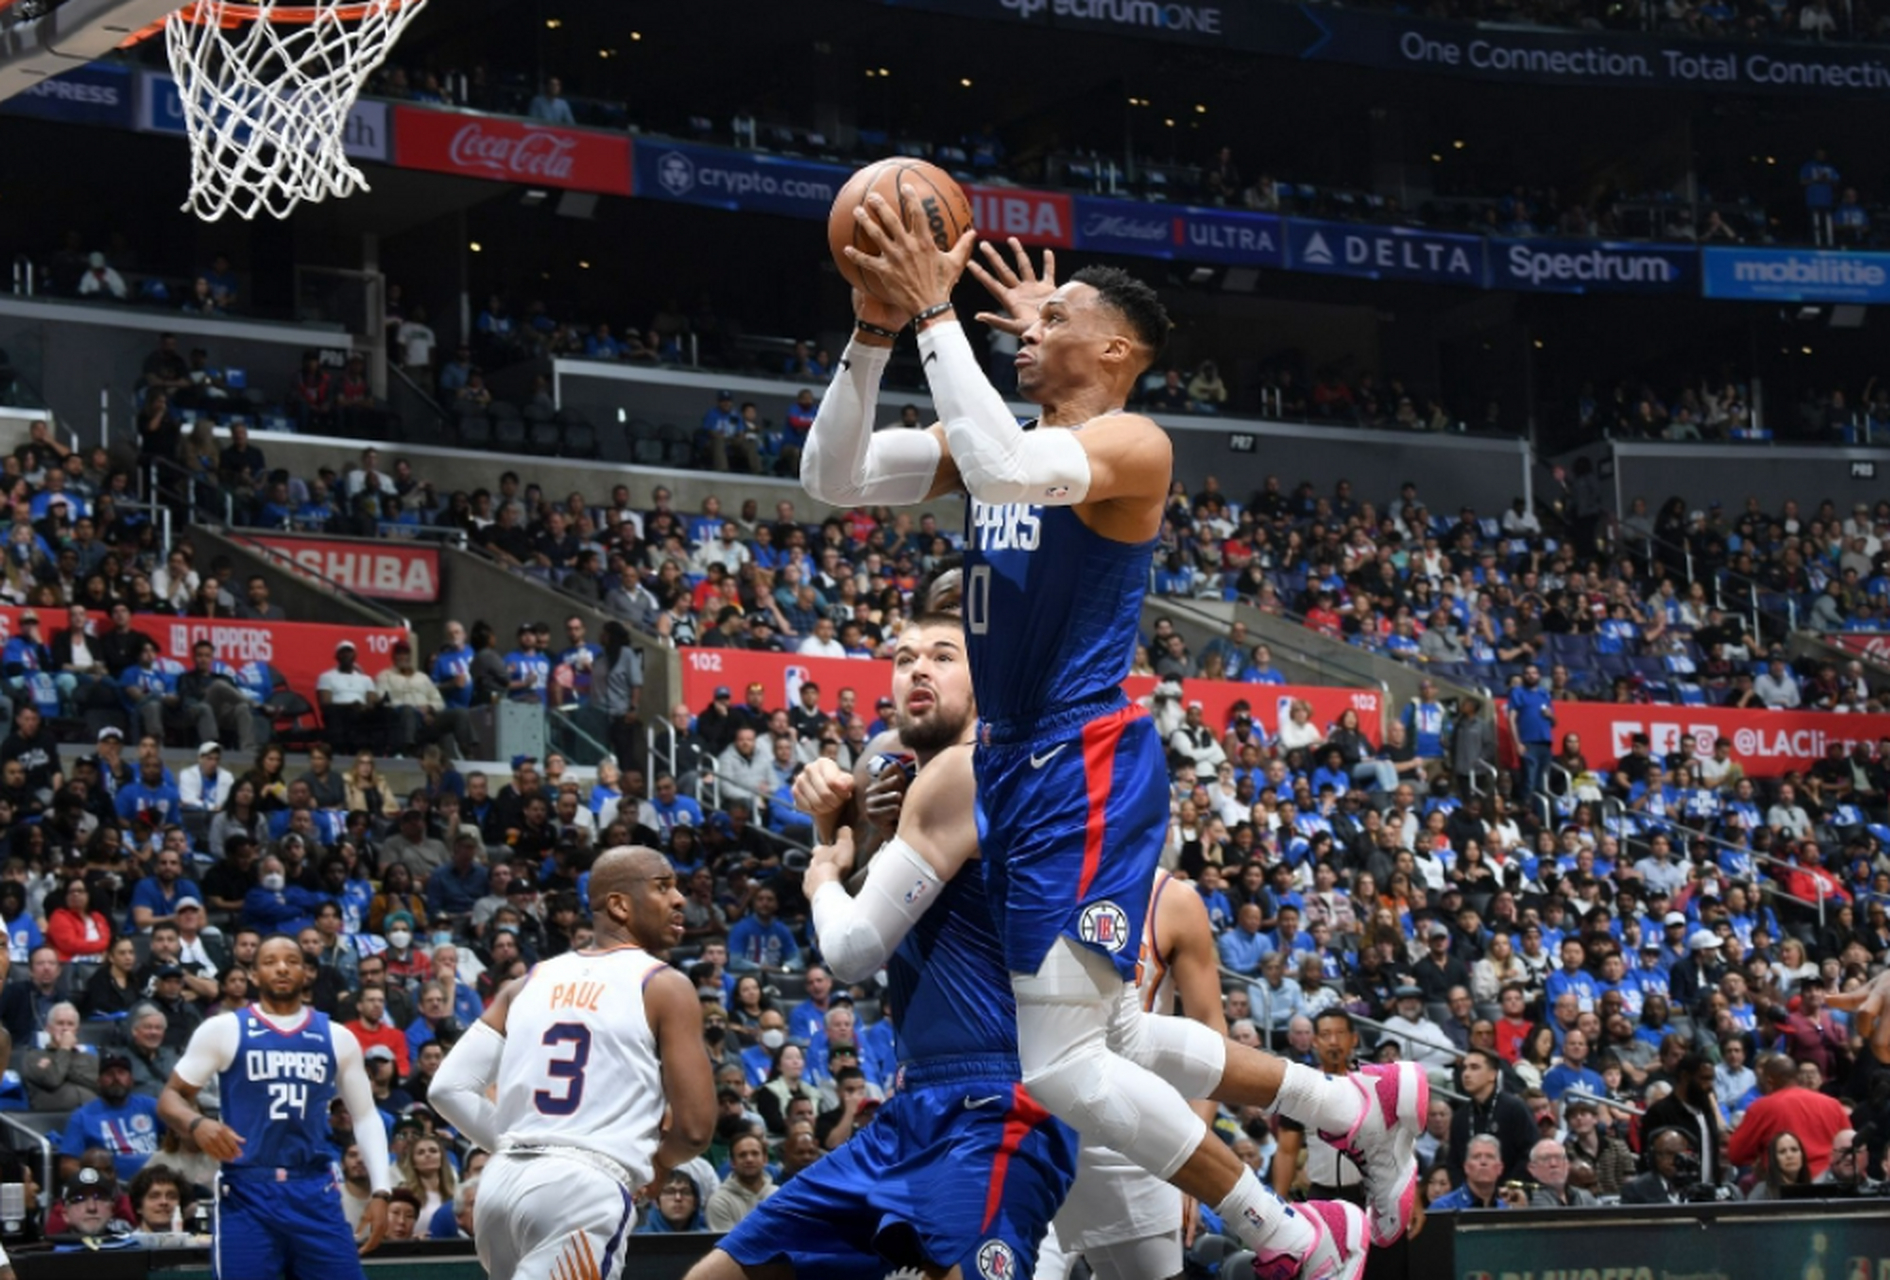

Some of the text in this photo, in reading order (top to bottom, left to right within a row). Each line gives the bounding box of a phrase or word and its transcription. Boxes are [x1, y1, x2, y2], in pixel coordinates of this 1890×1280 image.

[1400, 31, 1460, 65] One
[1468, 39, 1654, 77] Connection.
[1661, 49, 1738, 81] Total
[24, 80, 119, 106] XPRESS
[698, 167, 833, 200] crypto.com
[1189, 222, 1277, 253] ULTRA
[1344, 235, 1473, 275] DELTA
[1508, 244, 1671, 286] Spectrum
[1733, 257, 1887, 286] mobilitie
[968, 564, 991, 635] 0
[689, 652, 723, 672] 102
[1350, 693, 1377, 711] 102
[551, 981, 606, 1012] PAUL
[245, 1048, 329, 1085] CLIPPERS
[532, 1021, 592, 1116] 3
[267, 1082, 308, 1121] 24
